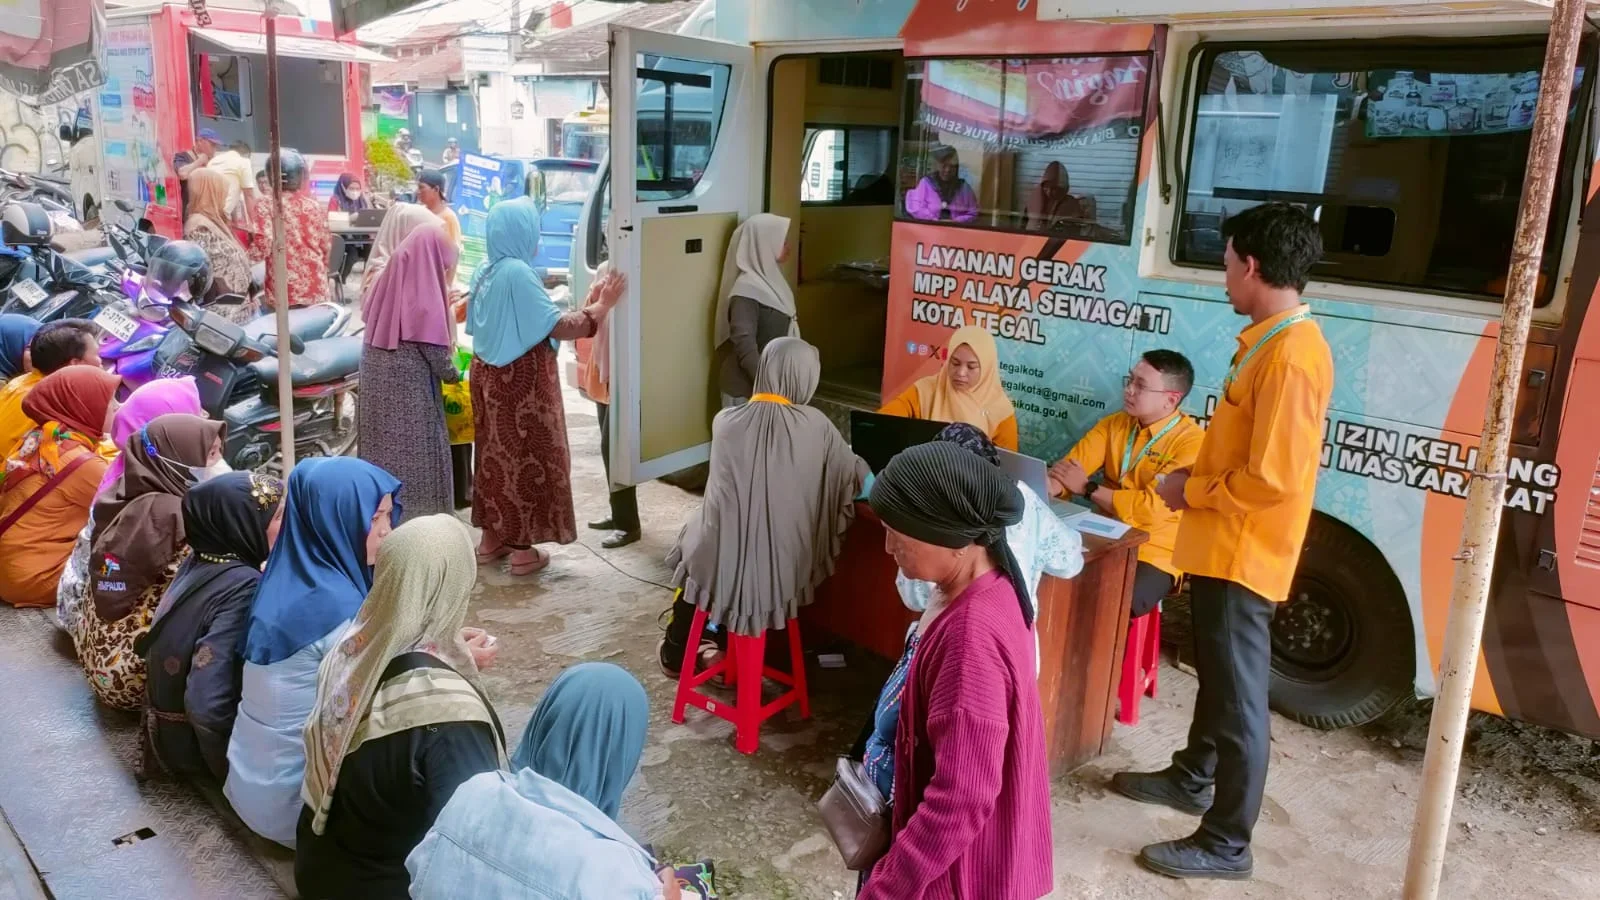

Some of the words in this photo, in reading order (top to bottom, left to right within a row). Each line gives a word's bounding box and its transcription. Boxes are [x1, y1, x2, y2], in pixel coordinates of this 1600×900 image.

[916, 244, 1015, 278] LAYANAN
[1020, 257, 1108, 292] GERAK
[911, 300, 966, 329] KOTA
[971, 310, 1046, 344] TEGAL
[914, 271, 957, 299] MPP
[962, 279, 1033, 312] ALAYA
[1036, 291, 1171, 334] SEWAGATI
[1335, 420, 1399, 456] IZIN
[1404, 433, 1561, 489] KELING
